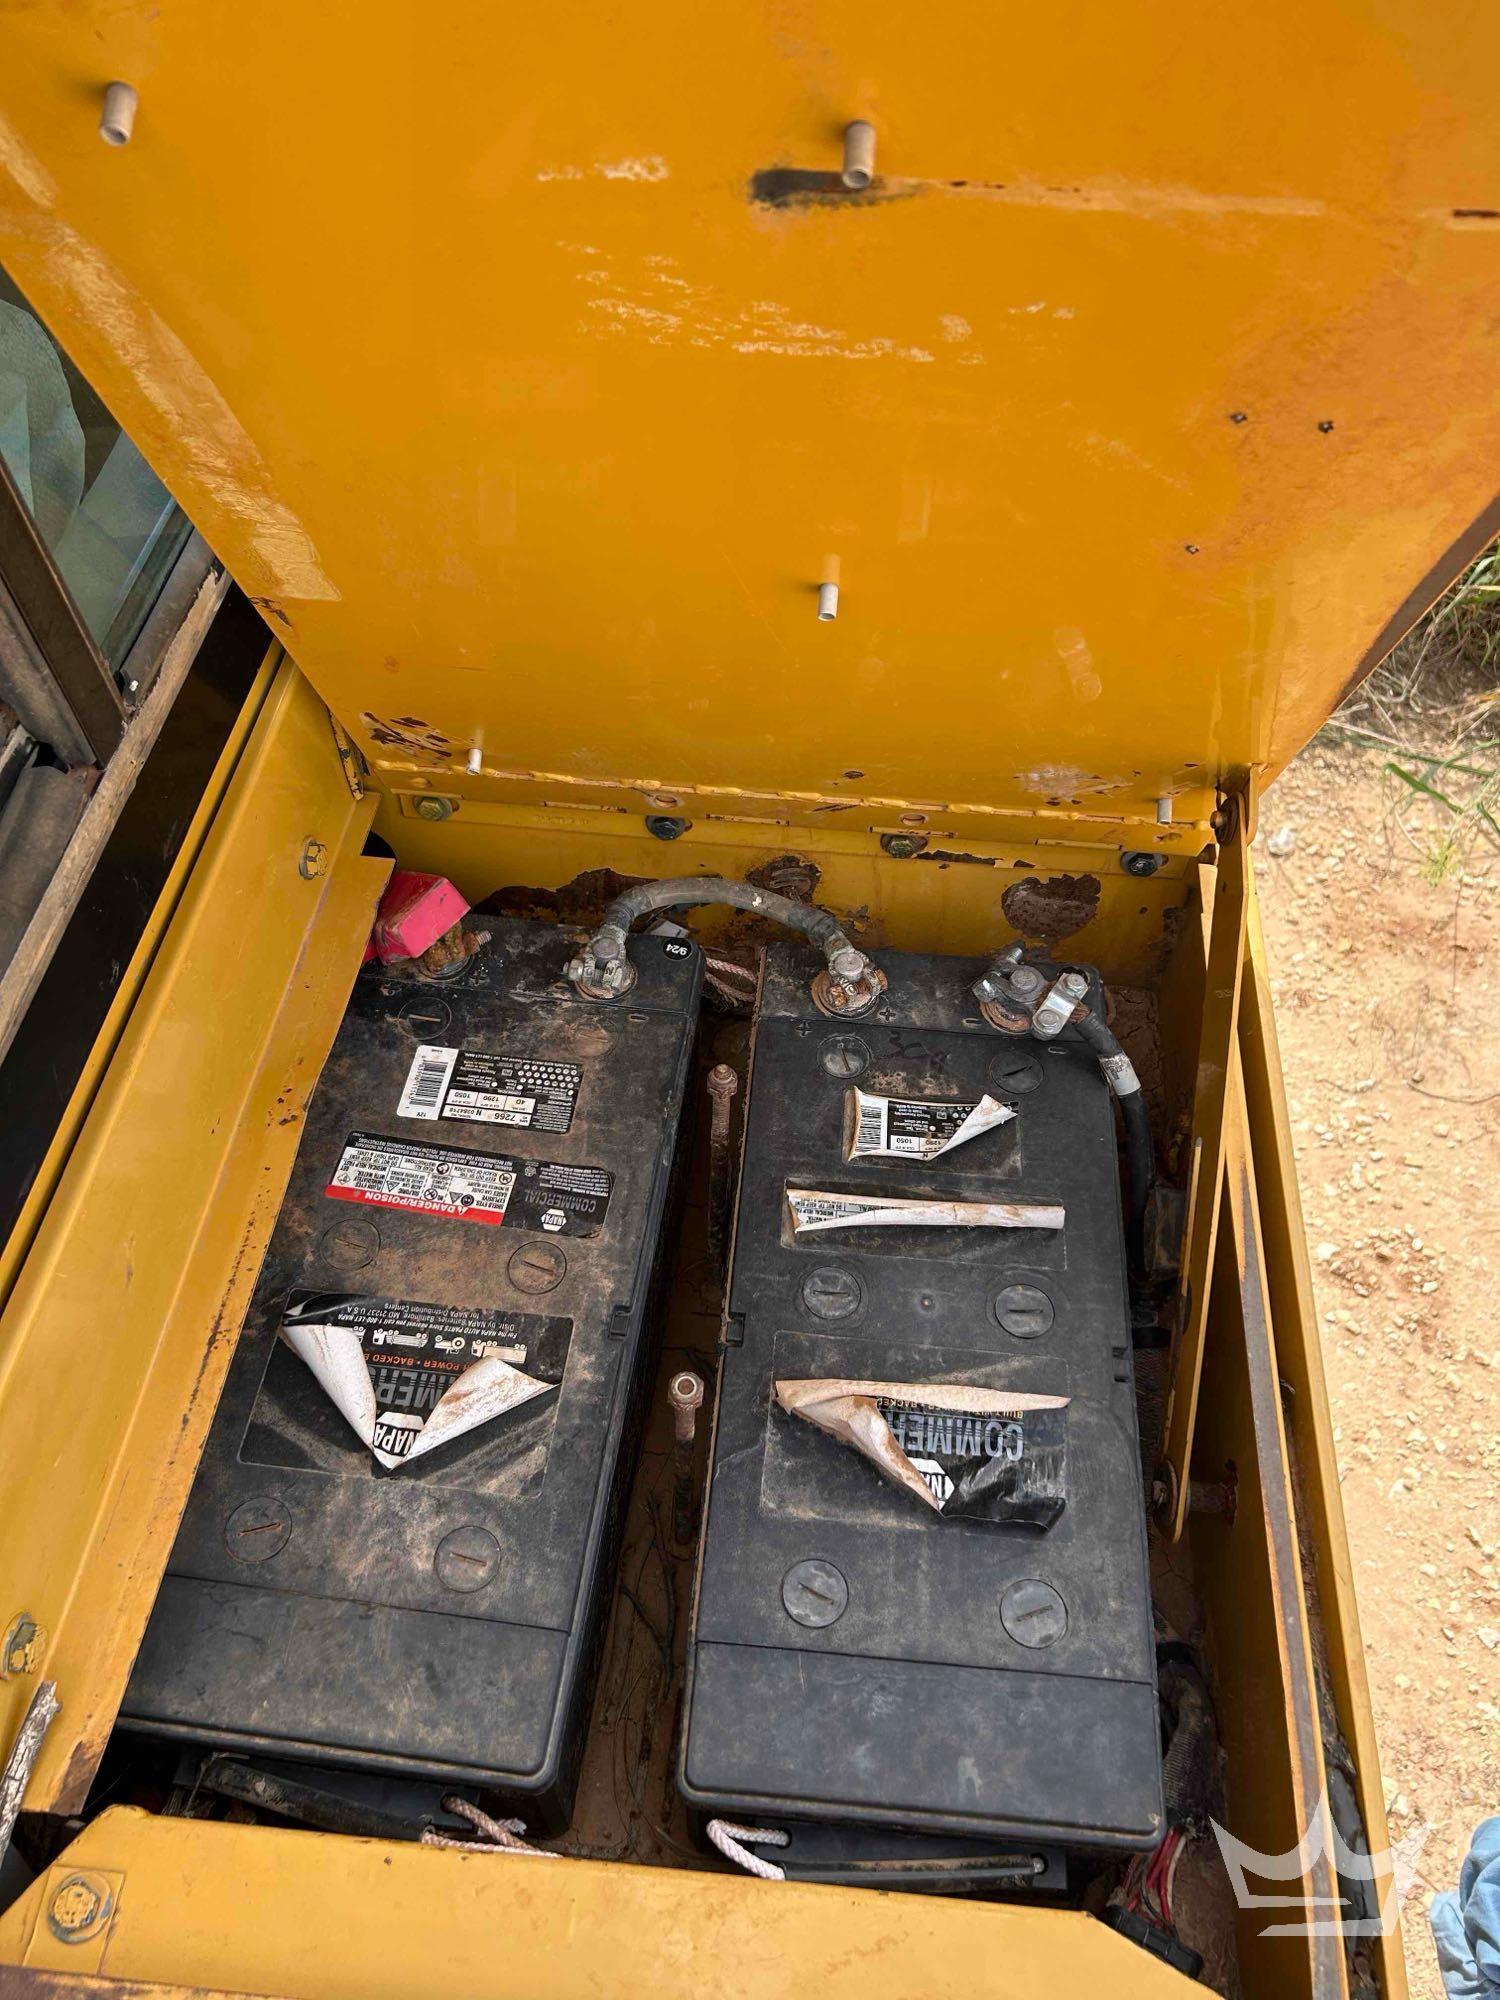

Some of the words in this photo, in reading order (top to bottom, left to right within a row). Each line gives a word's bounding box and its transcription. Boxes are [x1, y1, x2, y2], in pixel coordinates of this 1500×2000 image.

[666, 943, 688, 956] 9/24
[454, 1092, 471, 1100] 1050
[494, 1112, 516, 1122] 7266
[896, 1137, 913, 1145] 1050
[364, 1191, 456, 1214] DANGER/POISON
[524, 1190, 597, 1213] COMMERCIAL
[545, 1213, 563, 1225] NAPA
[384, 1303, 410, 1313] Centers
[410, 1306, 448, 1318] Distribution
[367, 1308, 388, 1318] 21237
[388, 1310, 401, 1319] MD
[450, 1310, 468, 1319] NAPA
[469, 1312, 480, 1321] for
[383, 1318, 395, 1327] call
[395, 1318, 406, 1326] you
[407, 1321, 429, 1330] nearest
[467, 1319, 487, 1329] NAPA
[487, 1321, 497, 1330] by
[444, 1325, 464, 1334] PARTS
[464, 1328, 480, 1336] AUTO
[480, 1329, 497, 1338] NAPA
[497, 1331, 507, 1339] the
[507, 1332, 518, 1340] For
[372, 1353, 414, 1365] BACKED
[423, 1359, 460, 1371] POWER
[368, 1367, 457, 1411] MER
[373, 1425, 420, 1456] NAPA
